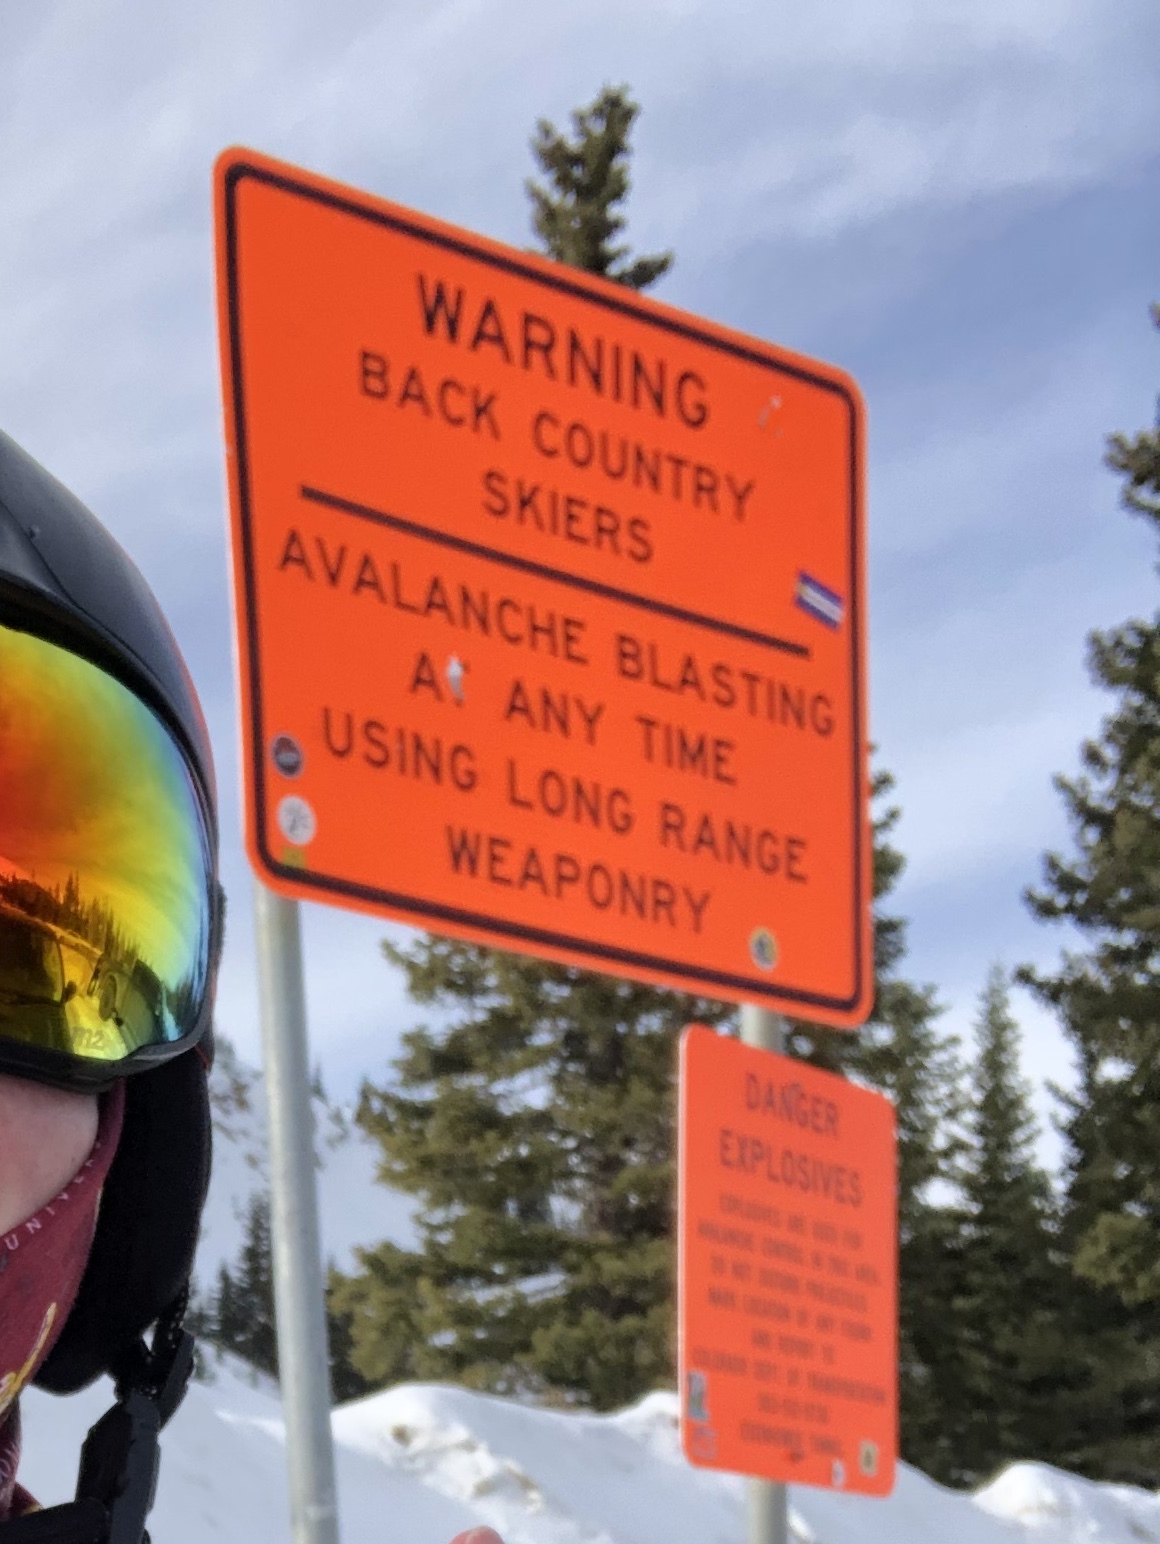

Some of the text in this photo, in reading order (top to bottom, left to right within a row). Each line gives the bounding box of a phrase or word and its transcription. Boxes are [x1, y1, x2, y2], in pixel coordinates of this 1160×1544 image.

[417, 271, 710, 431] WARNING
[359, 349, 755, 522] BACK COUNTRY
[482, 469, 654, 566] SKIERS
[279, 528, 836, 739] AVALANCHE BLASTING
[505, 678, 607, 747] ANY
[636, 714, 738, 788] TIME
[321, 705, 478, 793] USING
[507, 756, 636, 835] LONG
[659, 801, 809, 884] RANGE
[444, 823, 712, 936] WEAPONRY
[746, 1071, 839, 1137] DANGER
[719, 1128, 863, 1209] EXPLOSIVES
